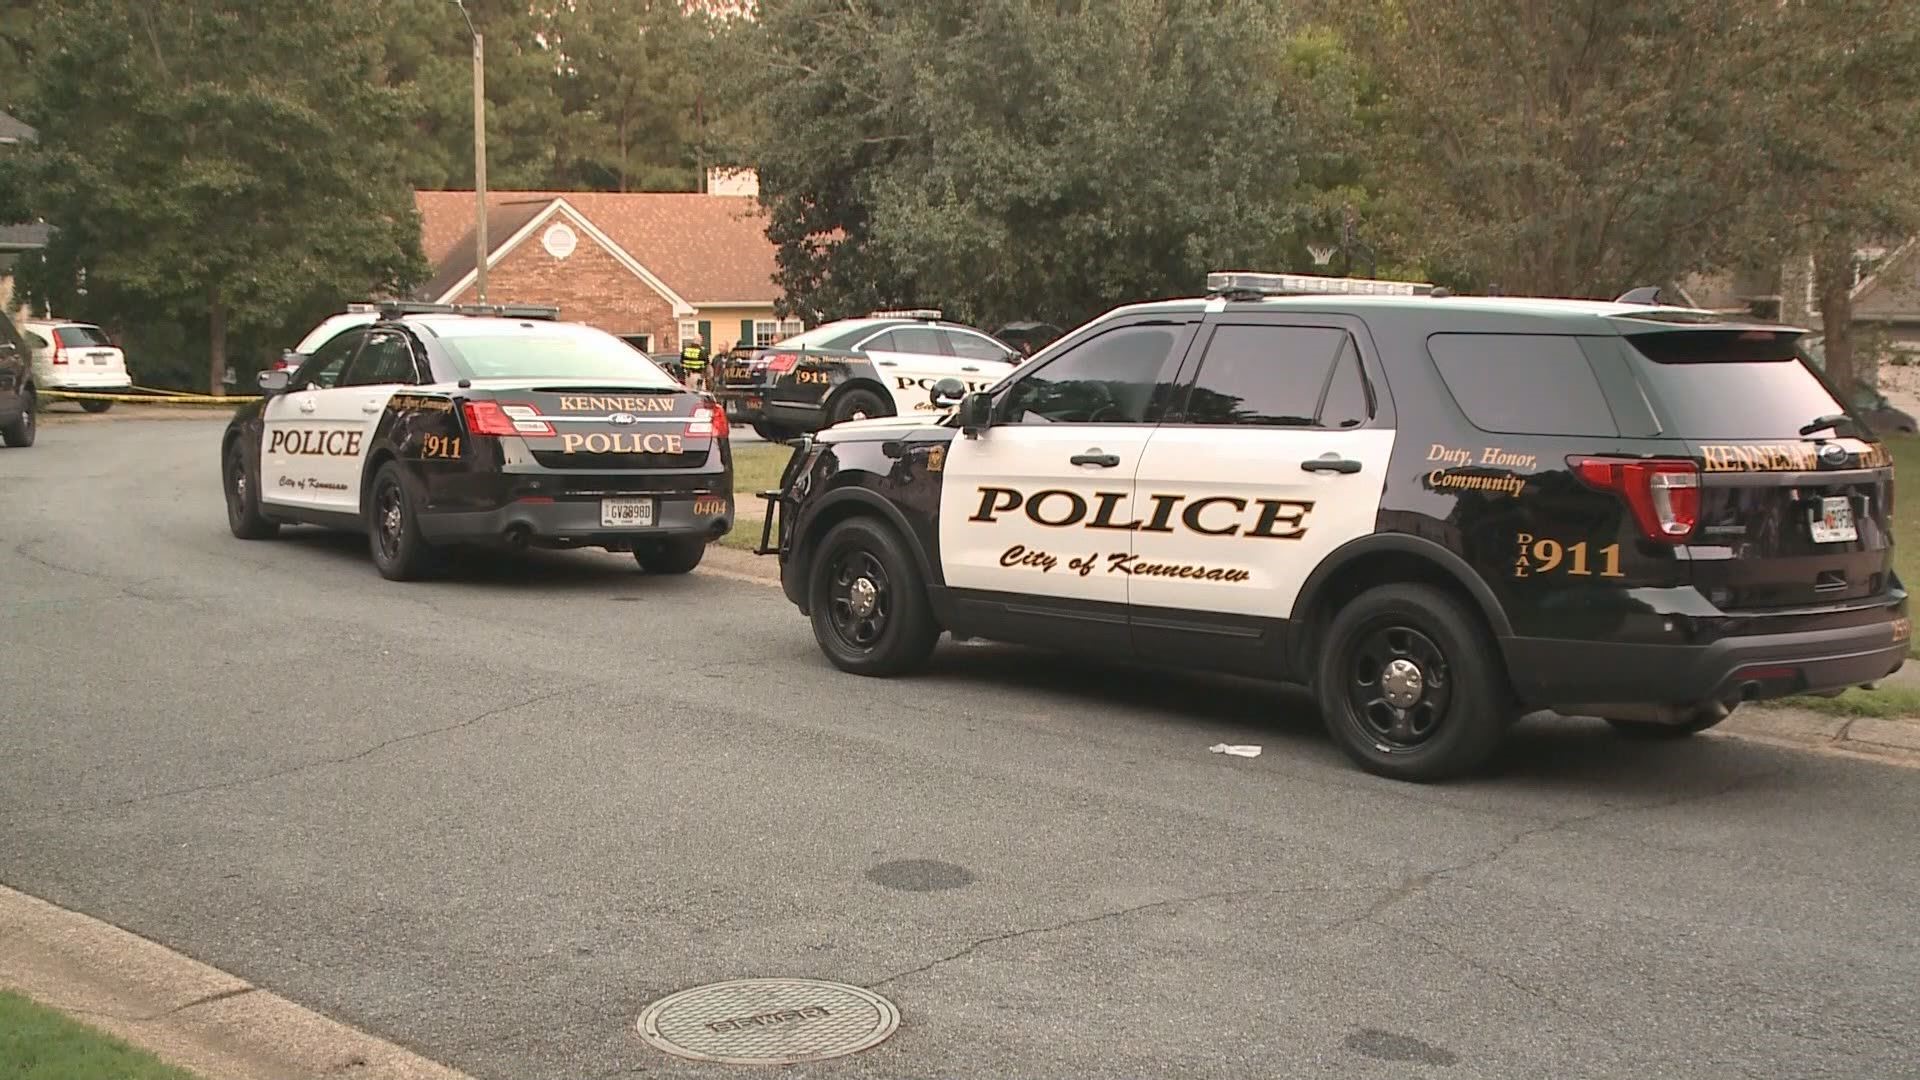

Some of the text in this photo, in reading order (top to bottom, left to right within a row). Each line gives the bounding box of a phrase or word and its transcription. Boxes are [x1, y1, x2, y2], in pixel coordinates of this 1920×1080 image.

[801, 370, 828, 384] 911
[559, 396, 676, 412] KENNESAW
[268, 430, 364, 457] POLICE
[428, 436, 462, 459] 911
[561, 433, 684, 454] POLICE
[1427, 444, 1537, 470] Duty, Honor,
[1700, 444, 1817, 471] KENNESAW
[279, 475, 296, 488] City
[1429, 469, 1526, 497] Community
[694, 500, 727, 515] 0404
[968, 486, 1317, 541] POLICE
[999, 545, 1250, 582] City of Kennesaw
[1514, 533, 1533, 577] DIAL
[1534, 539, 1626, 577] 911
